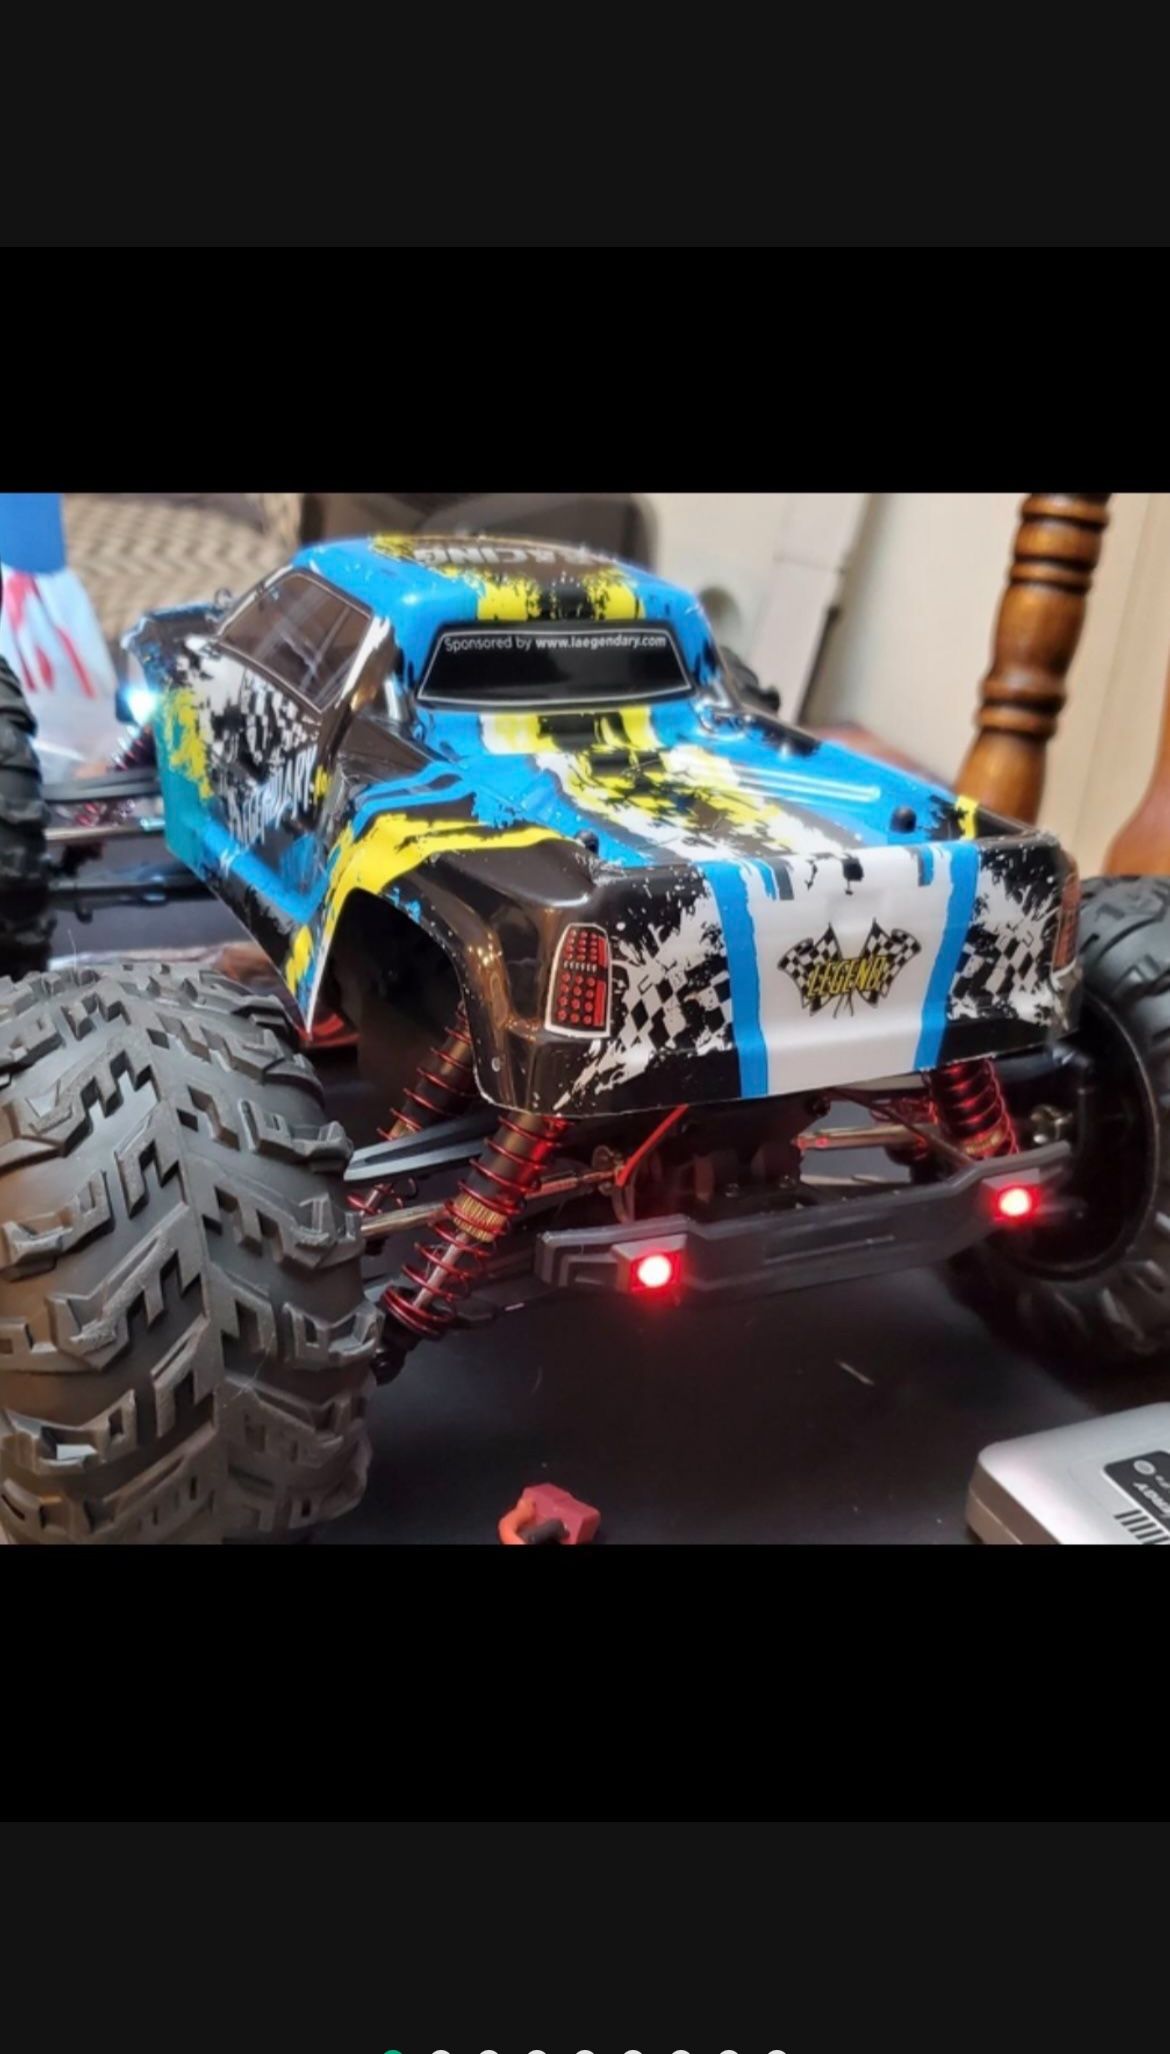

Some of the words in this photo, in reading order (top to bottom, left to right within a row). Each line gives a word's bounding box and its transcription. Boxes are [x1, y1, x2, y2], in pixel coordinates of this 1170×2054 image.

[444, 635, 512, 651] Sponsored
[515, 636, 532, 650] by
[535, 634, 666, 650] www.laegendary.com
